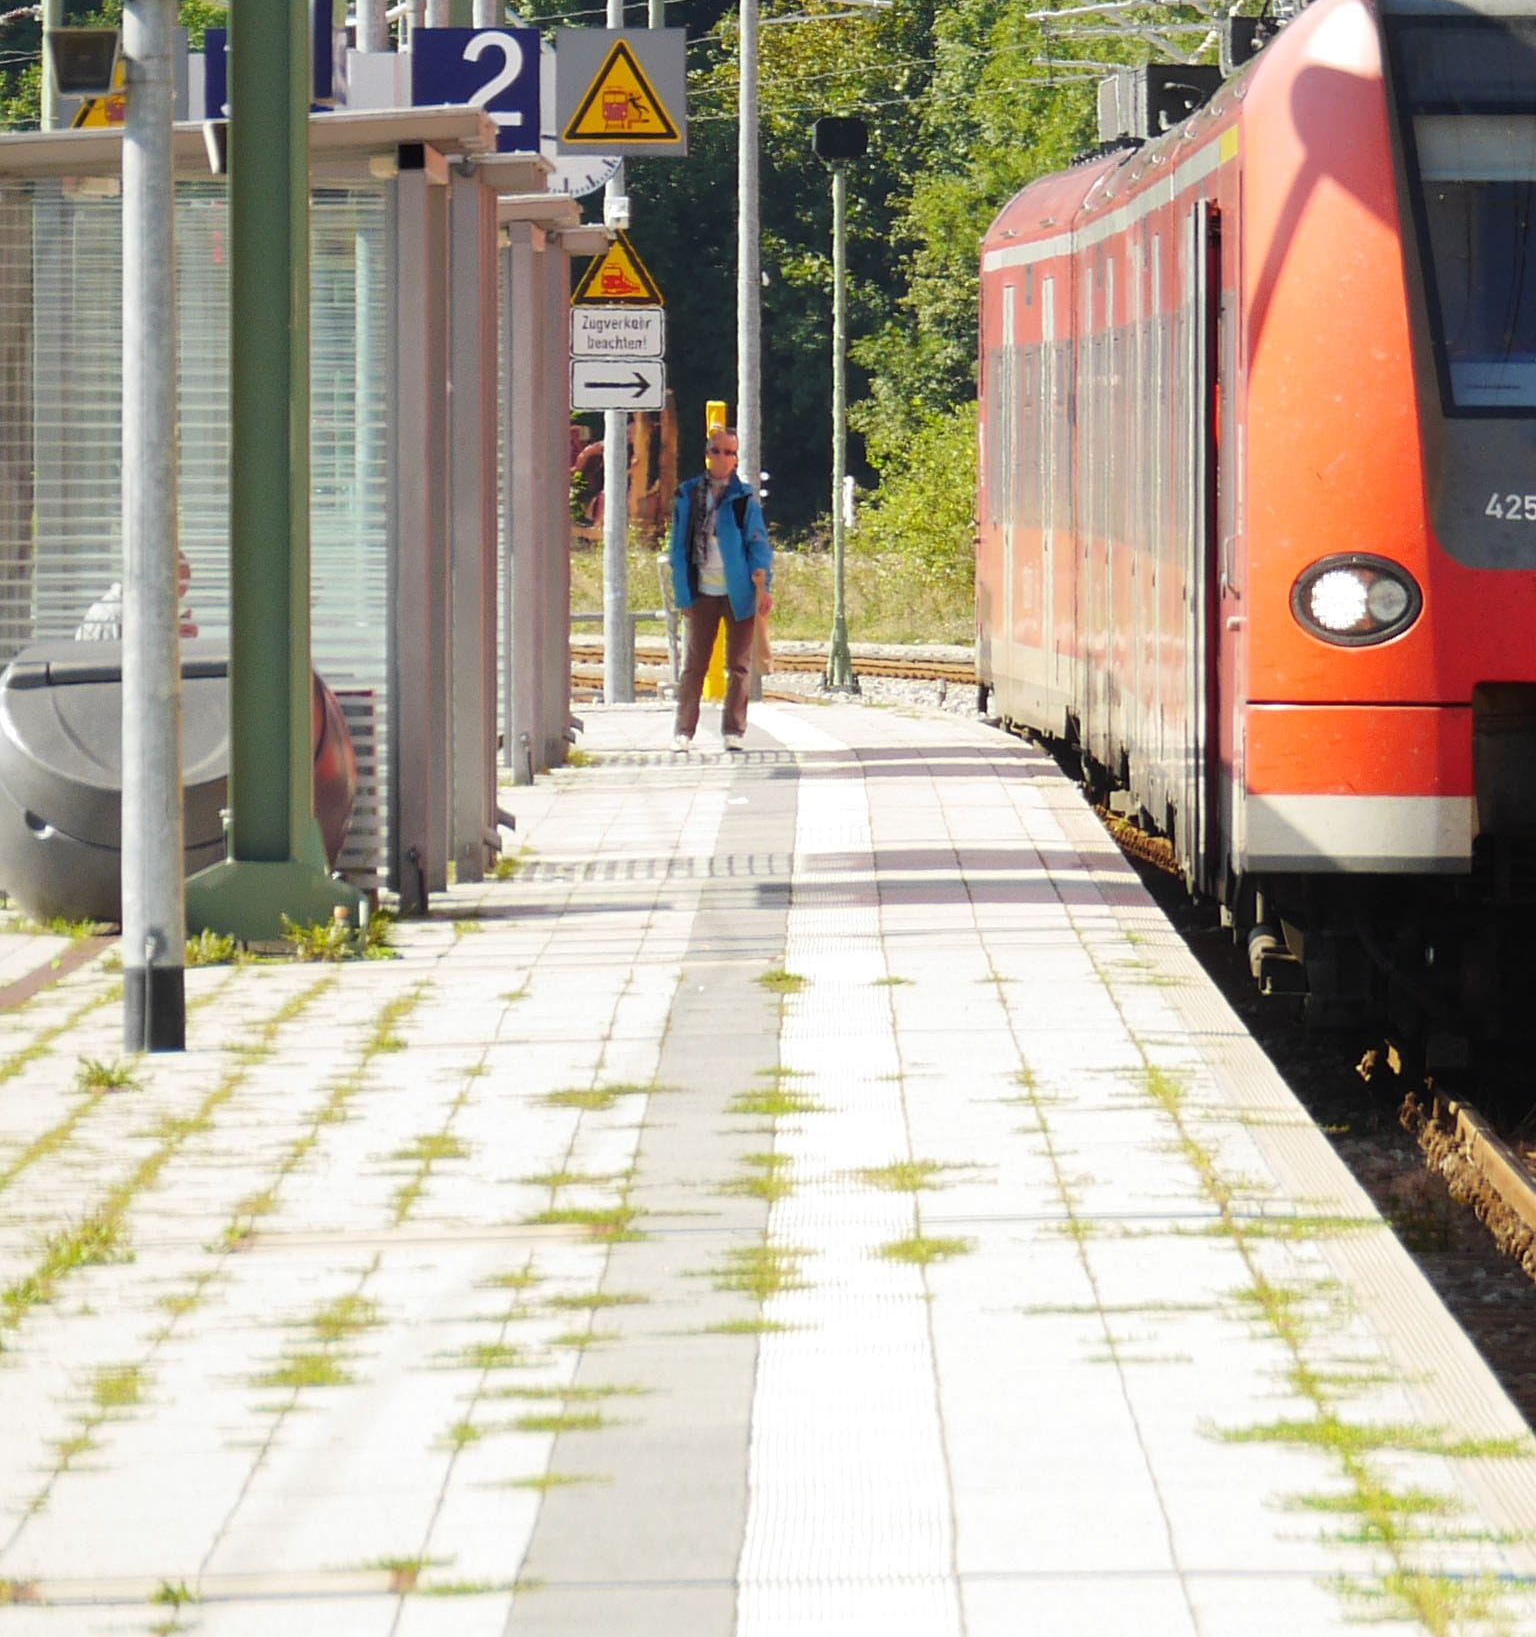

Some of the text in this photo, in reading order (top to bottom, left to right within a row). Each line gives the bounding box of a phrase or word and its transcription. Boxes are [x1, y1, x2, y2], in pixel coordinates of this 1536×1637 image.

[461, 31, 524, 126] 2
[582, 315, 653, 334] Zugverkehr
[586, 334, 648, 350] beachten!
